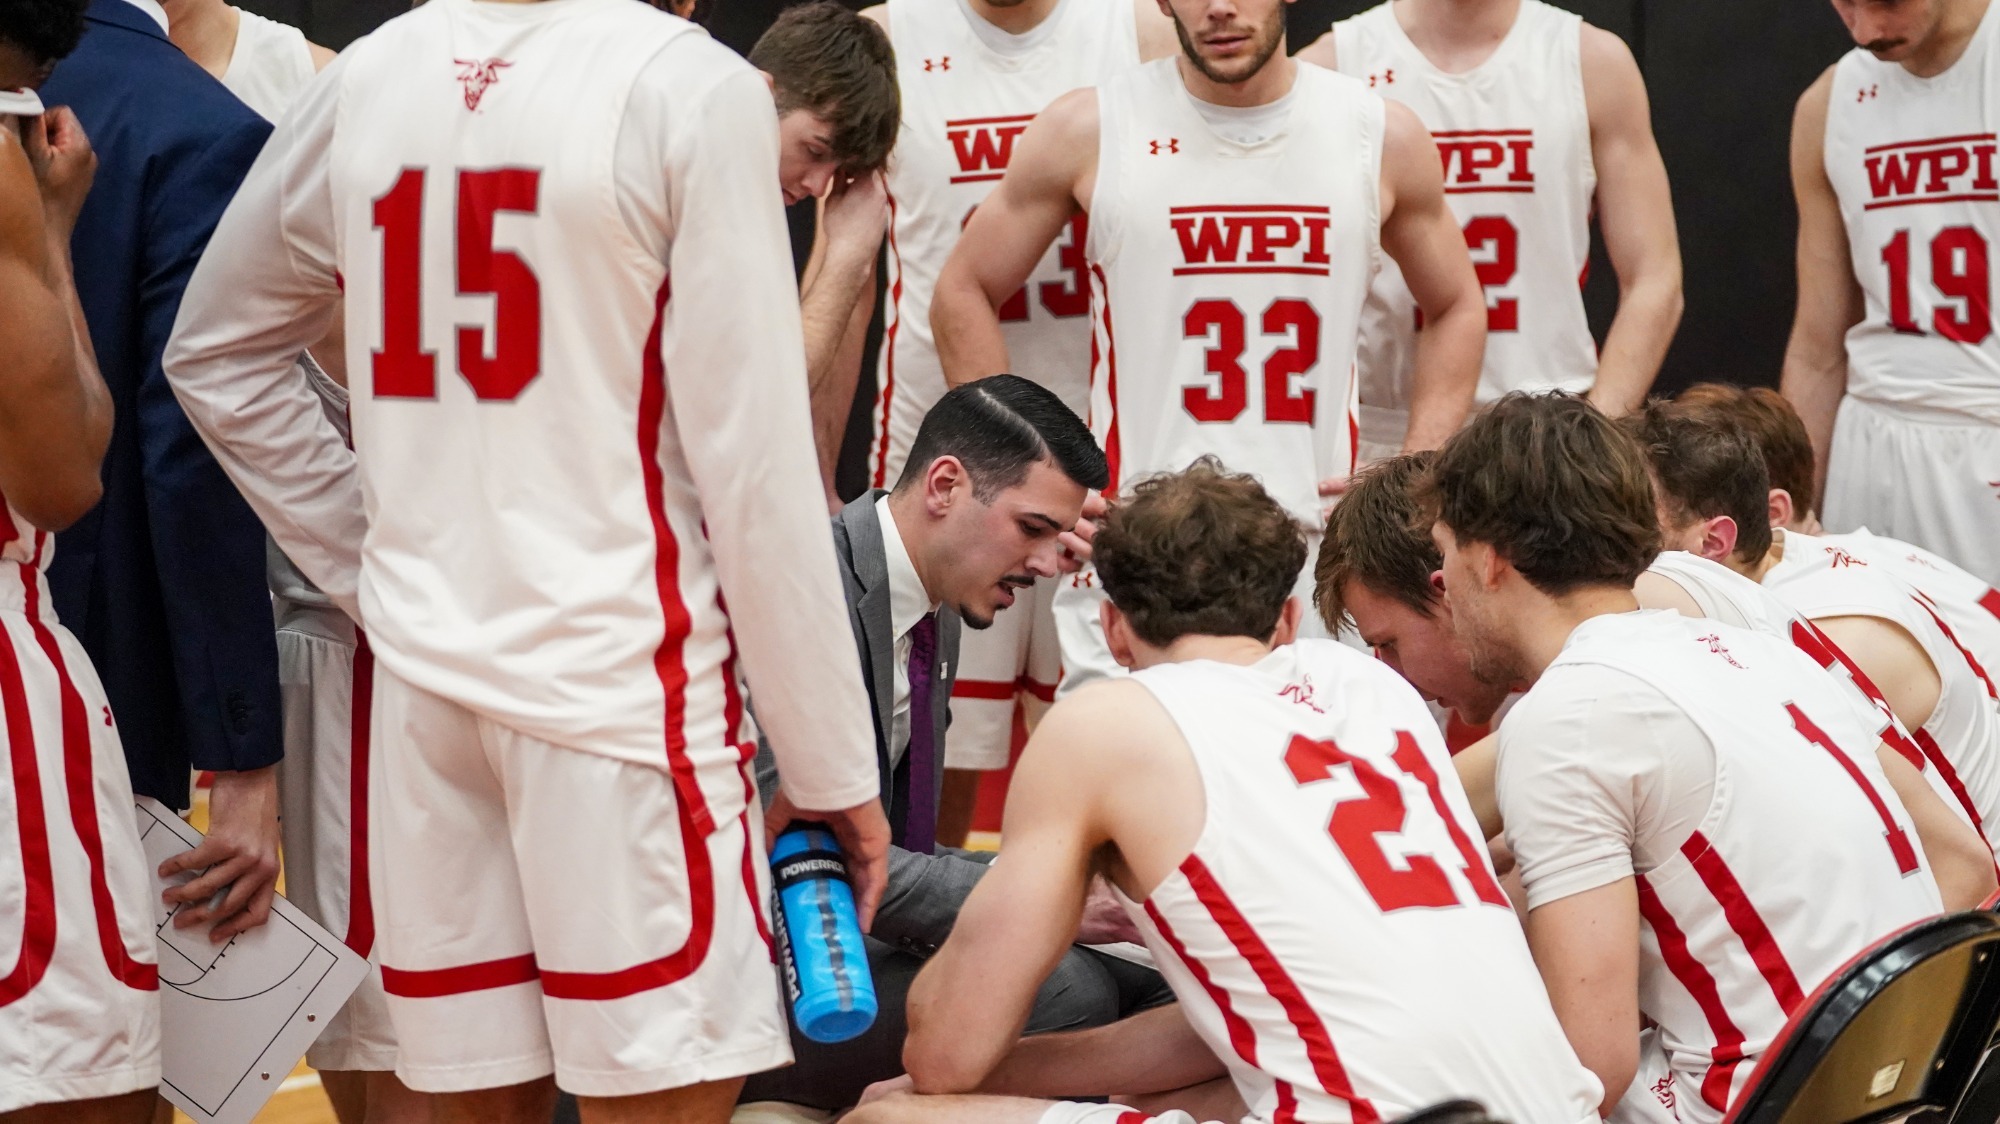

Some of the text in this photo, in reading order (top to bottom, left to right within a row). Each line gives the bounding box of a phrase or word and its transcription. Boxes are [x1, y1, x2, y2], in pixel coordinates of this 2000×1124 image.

[1864, 145, 1999, 198] WPI
[370, 165, 544, 405] 15
[1170, 216, 1331, 265] WPI
[1880, 223, 1993, 347] 19
[1181, 296, 1323, 427] 32
[1280, 728, 1516, 916] 21
[1781, 699, 1923, 878] 1
